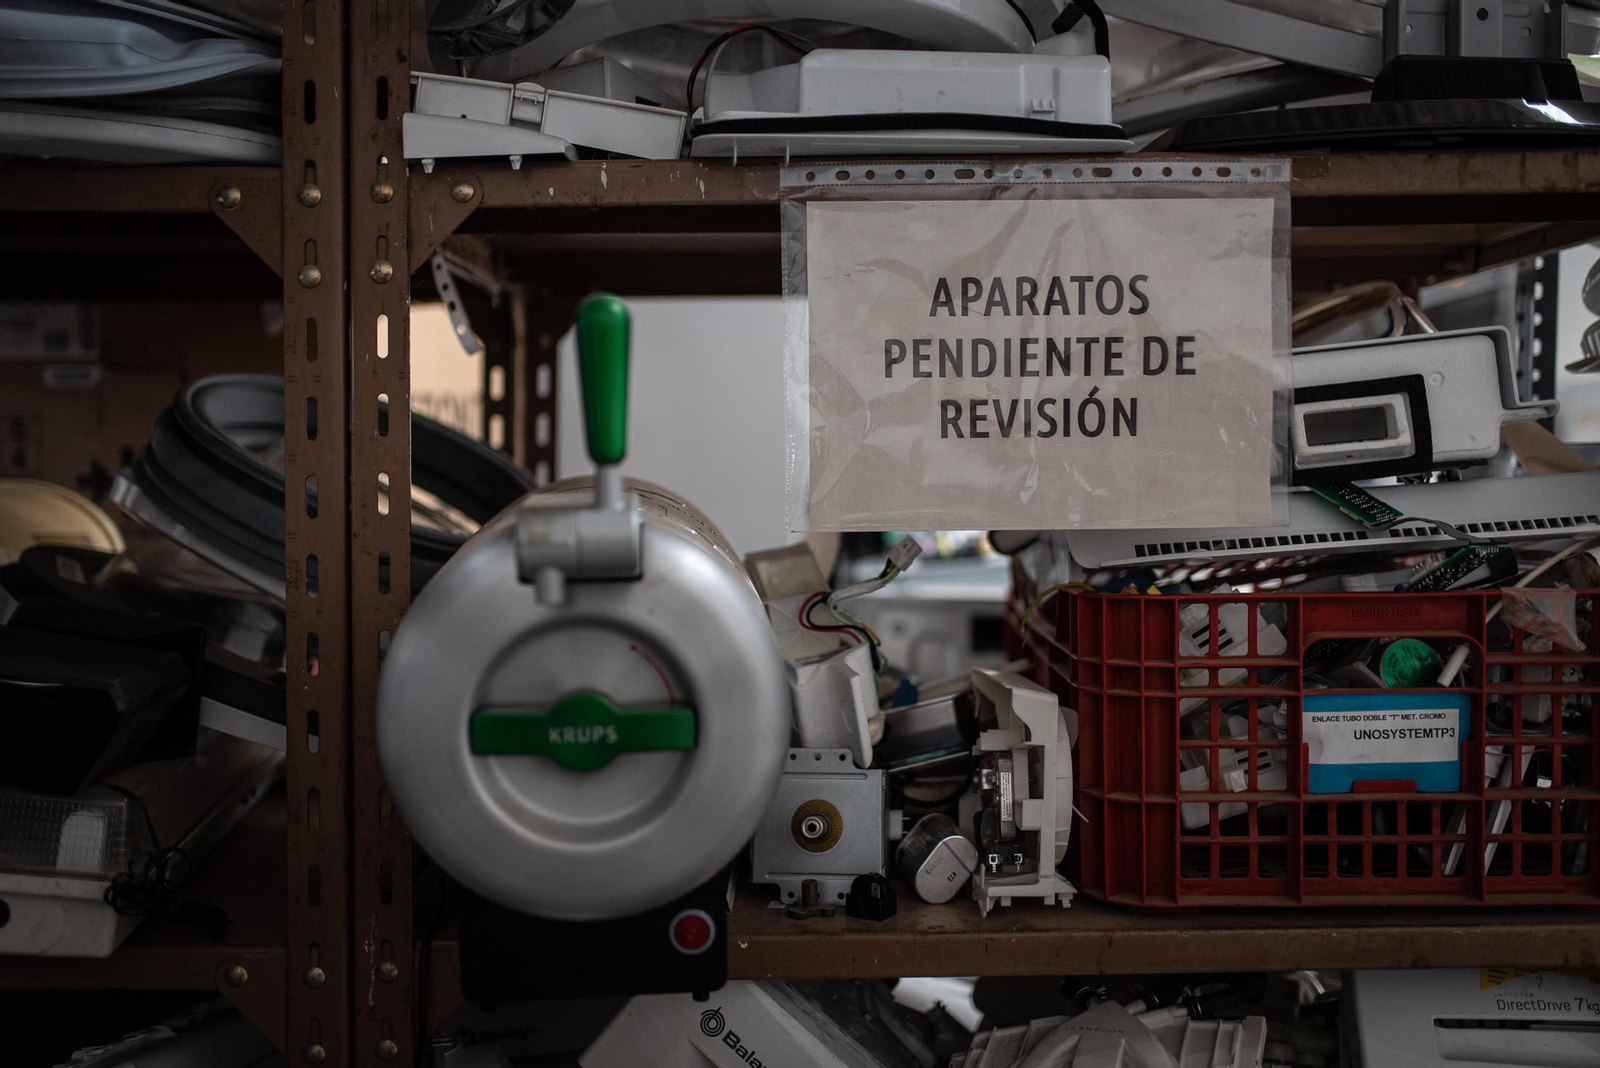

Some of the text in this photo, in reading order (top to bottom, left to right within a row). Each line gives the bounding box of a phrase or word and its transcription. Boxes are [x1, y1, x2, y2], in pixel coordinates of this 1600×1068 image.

[929, 274, 1150, 317] APARATOS
[884, 335, 1197, 378] PENDIENTE DE
[940, 385, 1138, 439] REVISIÓN
[1312, 715, 1340, 723] ENLACE
[548, 724, 618, 744] KRUPS
[1354, 727, 1455, 740] UNOSYSTEMTP3
[1497, 999, 1571, 1011] DirectDrive
